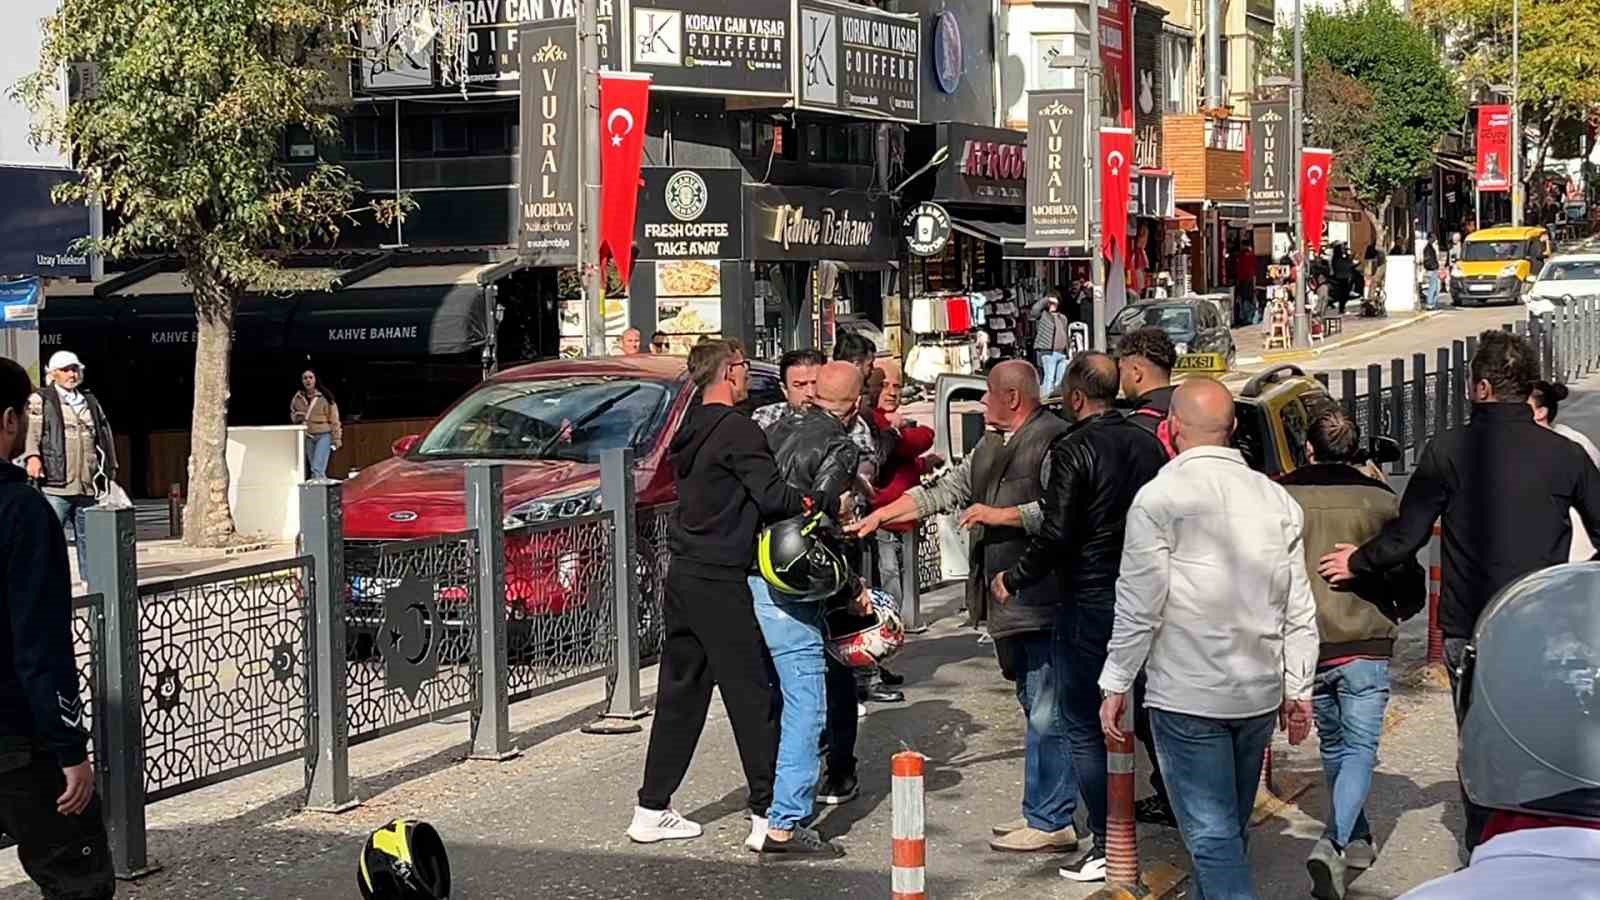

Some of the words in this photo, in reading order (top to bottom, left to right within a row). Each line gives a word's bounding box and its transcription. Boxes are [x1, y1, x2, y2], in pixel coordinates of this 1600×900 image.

[505, 0, 543, 22] CAN
[685, 14, 722, 32] KORAY
[724, 17, 747, 33] CAN
[749, 18, 785, 37] YAŞAR
[842, 16, 871, 45] KORAY
[872, 22, 889, 48] CAN
[890, 25, 917, 56] YAŞAR
[688, 33, 782, 52] COIFFEUR
[845, 50, 914, 81] COIFFEUR
[540, 67, 558, 199] VURAL
[1047, 119, 1063, 203] VURAL
[1263, 124, 1275, 189] VURAL
[774, 204, 821, 251] Kahve
[902, 205, 925, 227] TAKE
[925, 205, 949, 229] AWAY
[644, 224, 684, 238] FRESH
[685, 223, 729, 237] COFFEE
[654, 241, 688, 255] TAKE
[688, 241, 720, 255] AWAY
[37, 255, 55, 267] Uzay
[151, 331, 189, 344] KAHVE
[328, 328, 367, 342] KAHVE
[369, 326, 419, 340] BAHANE
